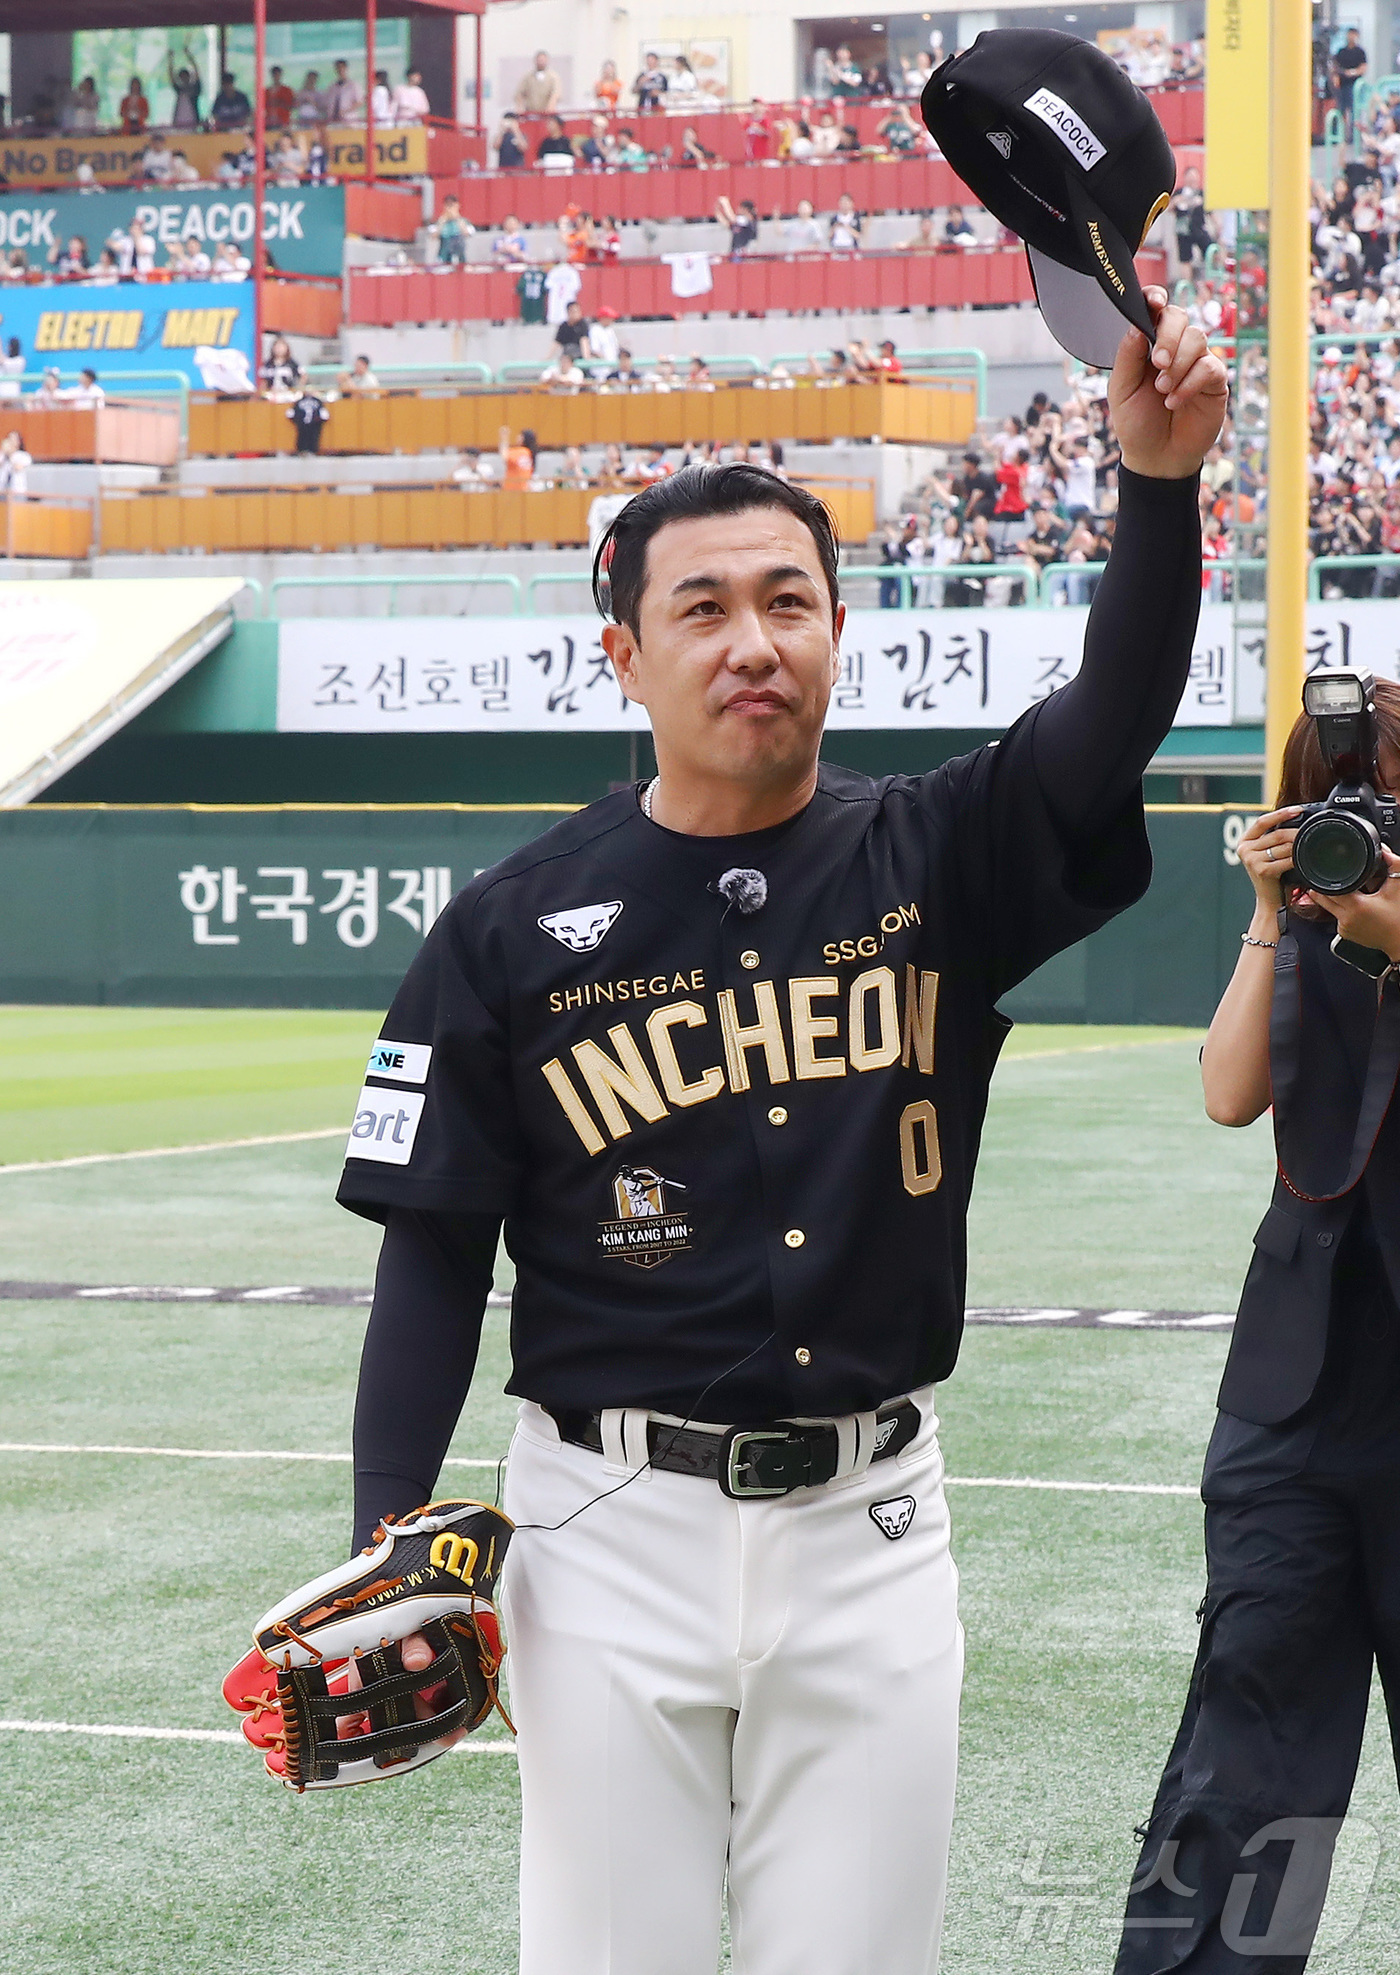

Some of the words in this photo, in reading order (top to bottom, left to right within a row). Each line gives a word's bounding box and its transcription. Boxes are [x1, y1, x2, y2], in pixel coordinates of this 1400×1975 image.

[1034, 95, 1099, 161] PEACOCK
[5, 149, 47, 174] No
[55, 147, 129, 173] Bran
[333, 137, 408, 164] rand
[135, 201, 305, 243] PEACOCK
[1086, 220, 1126, 296] REMEMBER
[162, 308, 239, 348] MART
[314, 656, 511, 711] 조선호텔
[883, 629, 989, 710] 김치
[1334, 796, 1361, 804] Canon
[823, 902, 922, 966] SSG.OM
[549, 970, 706, 1013] SHINSEGAE
[541, 962, 940, 1157] INCHEON
[900, 1099, 943, 1197] 0
[602, 1232, 625, 1246] KIM
[628, 1228, 661, 1243] KANG
[665, 1224, 688, 1239] MIN
[604, 1222, 639, 1233] LEGEND
[647, 1217, 684, 1228] INCHEON
